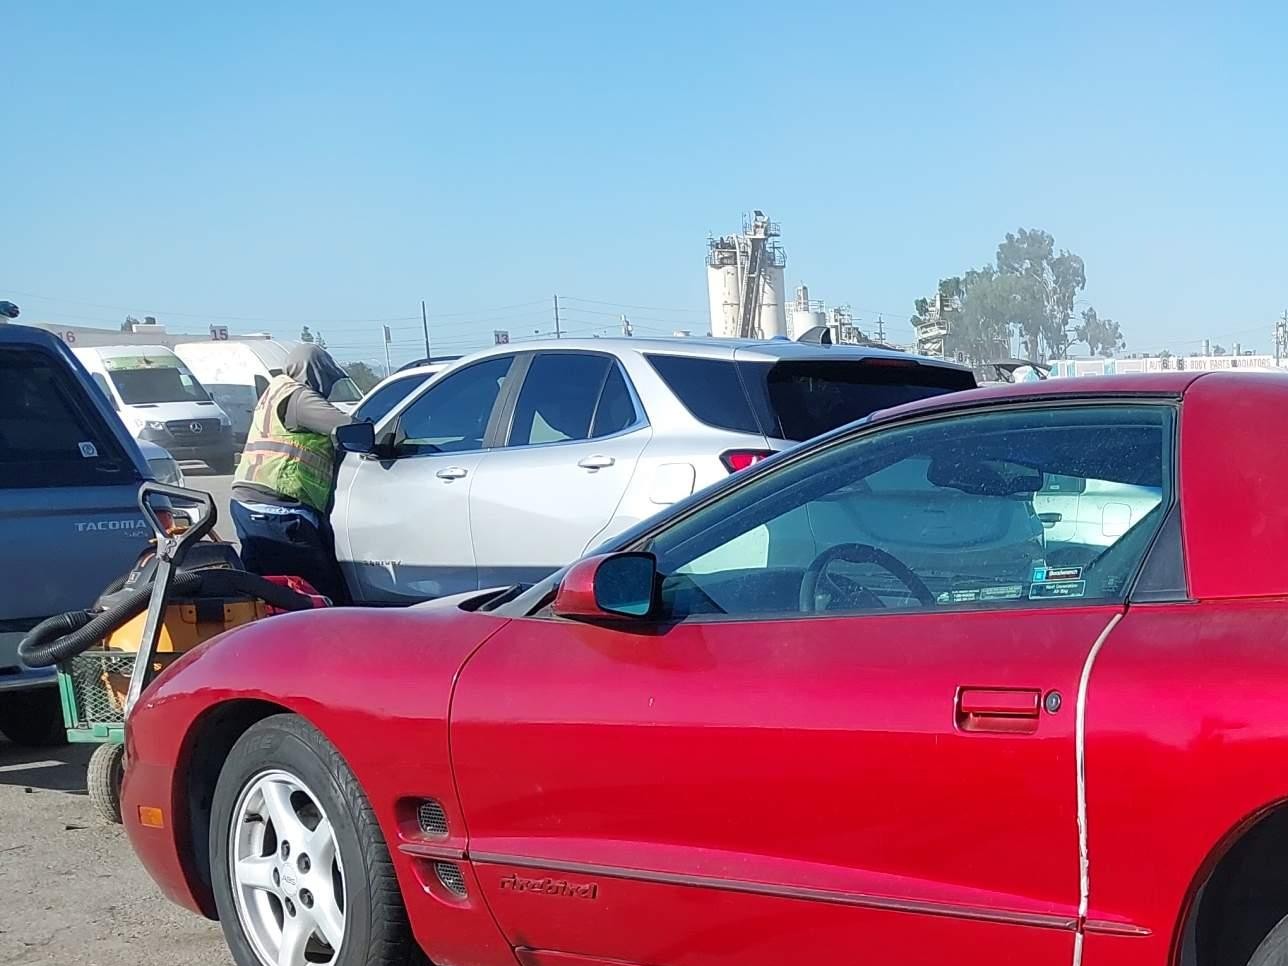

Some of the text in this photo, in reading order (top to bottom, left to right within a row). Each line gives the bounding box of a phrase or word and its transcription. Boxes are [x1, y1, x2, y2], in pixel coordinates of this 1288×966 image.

[210, 329, 228, 341] 15
[495, 333, 509, 344] 13
[74, 519, 146, 532] TACOMA
